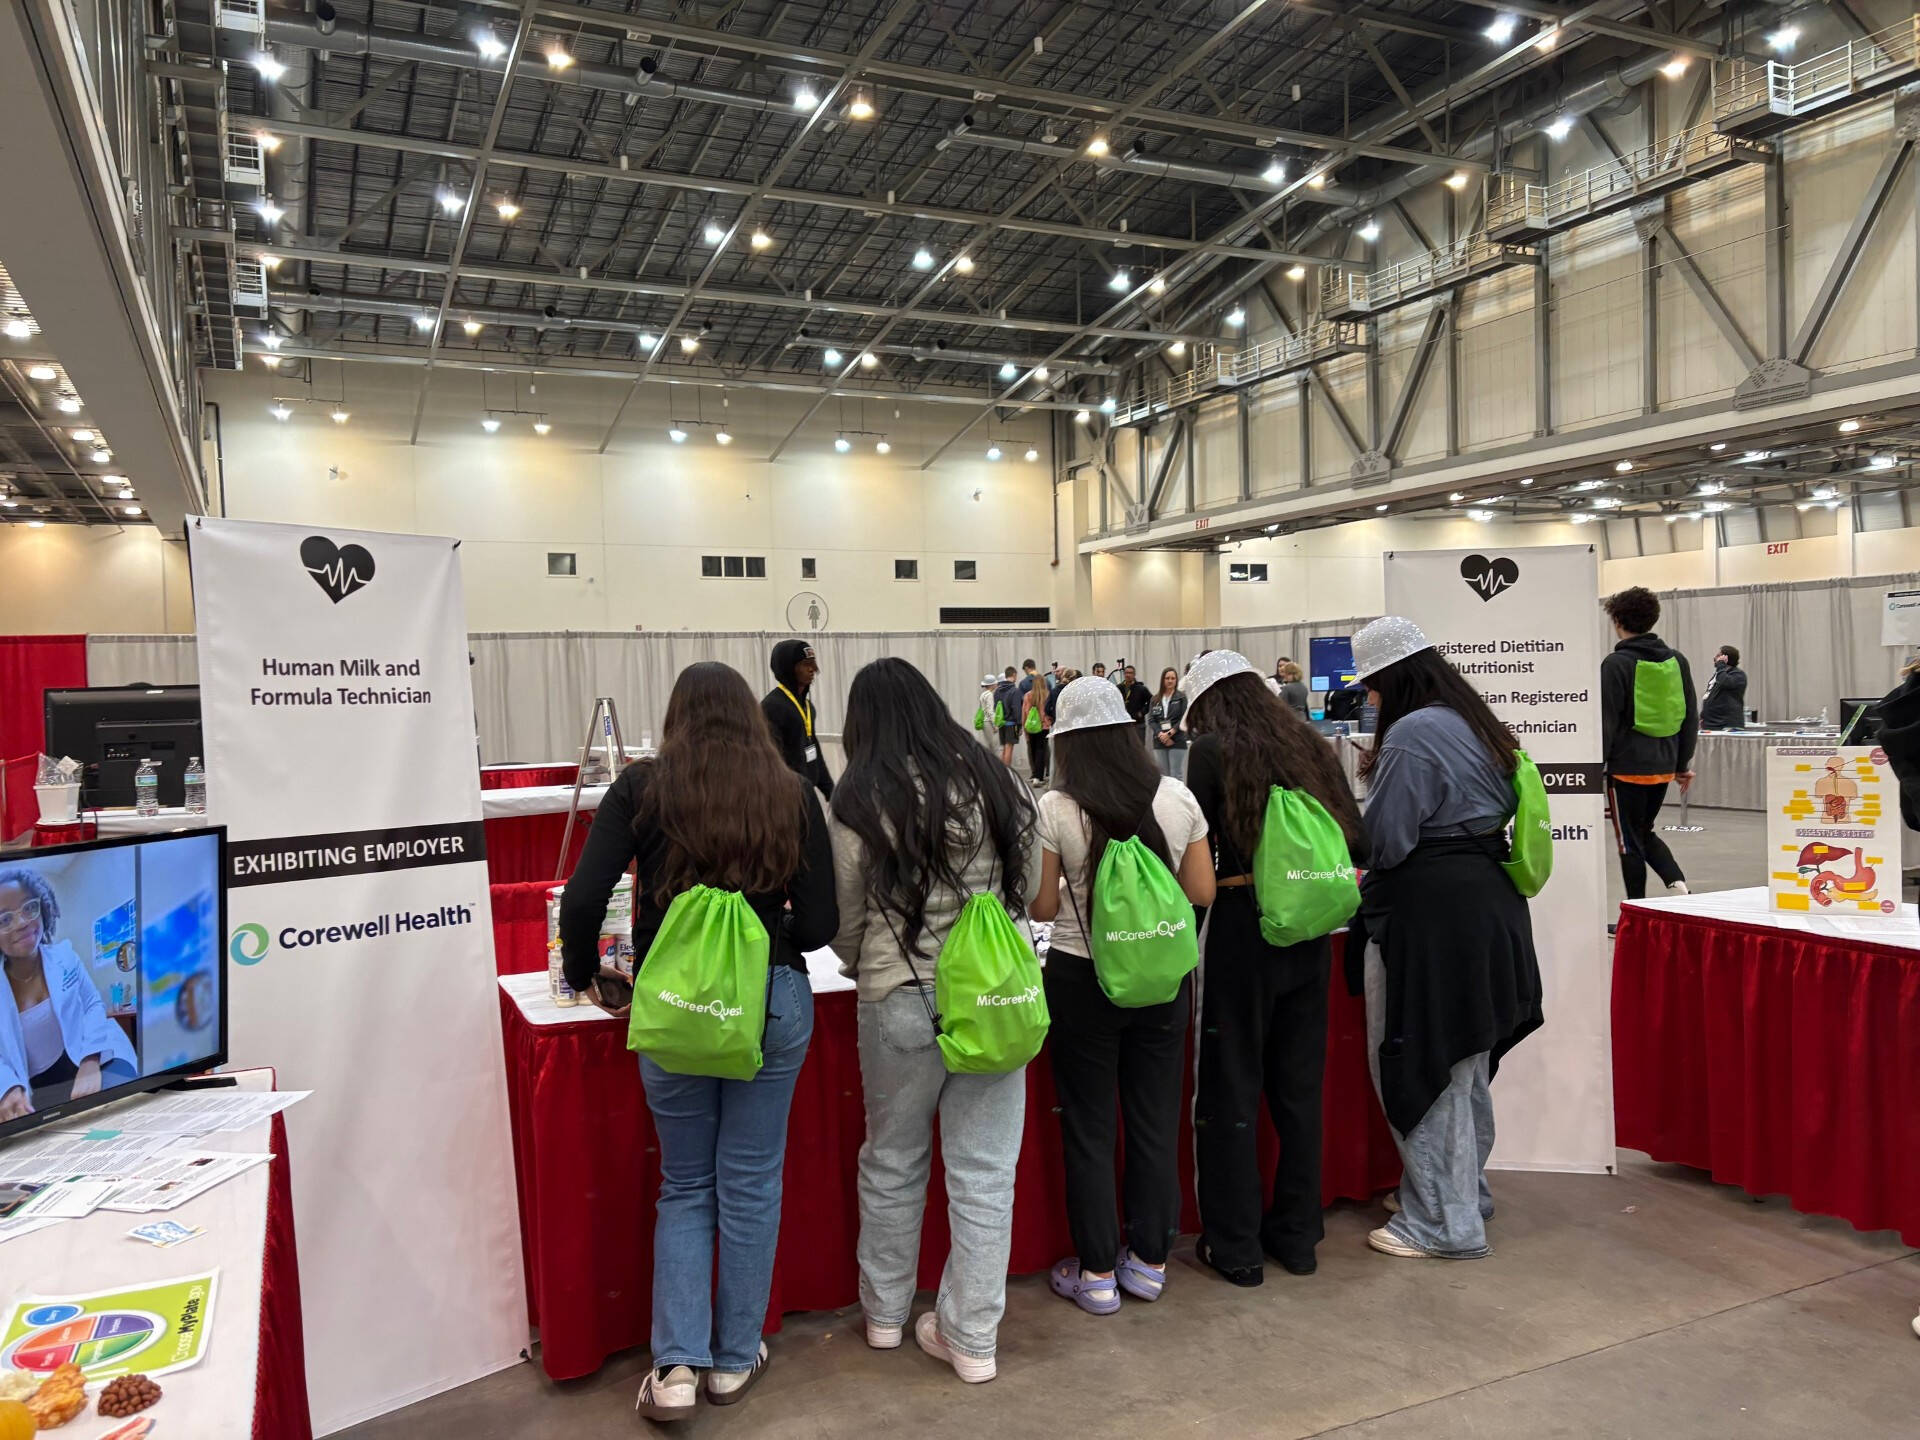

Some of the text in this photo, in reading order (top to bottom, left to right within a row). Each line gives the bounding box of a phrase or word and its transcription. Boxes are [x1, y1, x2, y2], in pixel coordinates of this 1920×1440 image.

[1195, 518, 1210, 529] EXIT
[1767, 542, 1789, 554] EXIT
[1431, 639, 1564, 657] egistered Dietitian
[262, 658, 421, 676] Human Milk and
[250, 687, 431, 705] Formula Technician
[1511, 690, 1588, 706] Registered
[1543, 773, 1586, 787] OYER
[1552, 825, 1588, 840] alth
[233, 836, 464, 875] EXHIBITING EMPLOYER
[278, 914, 390, 949] Corewell
